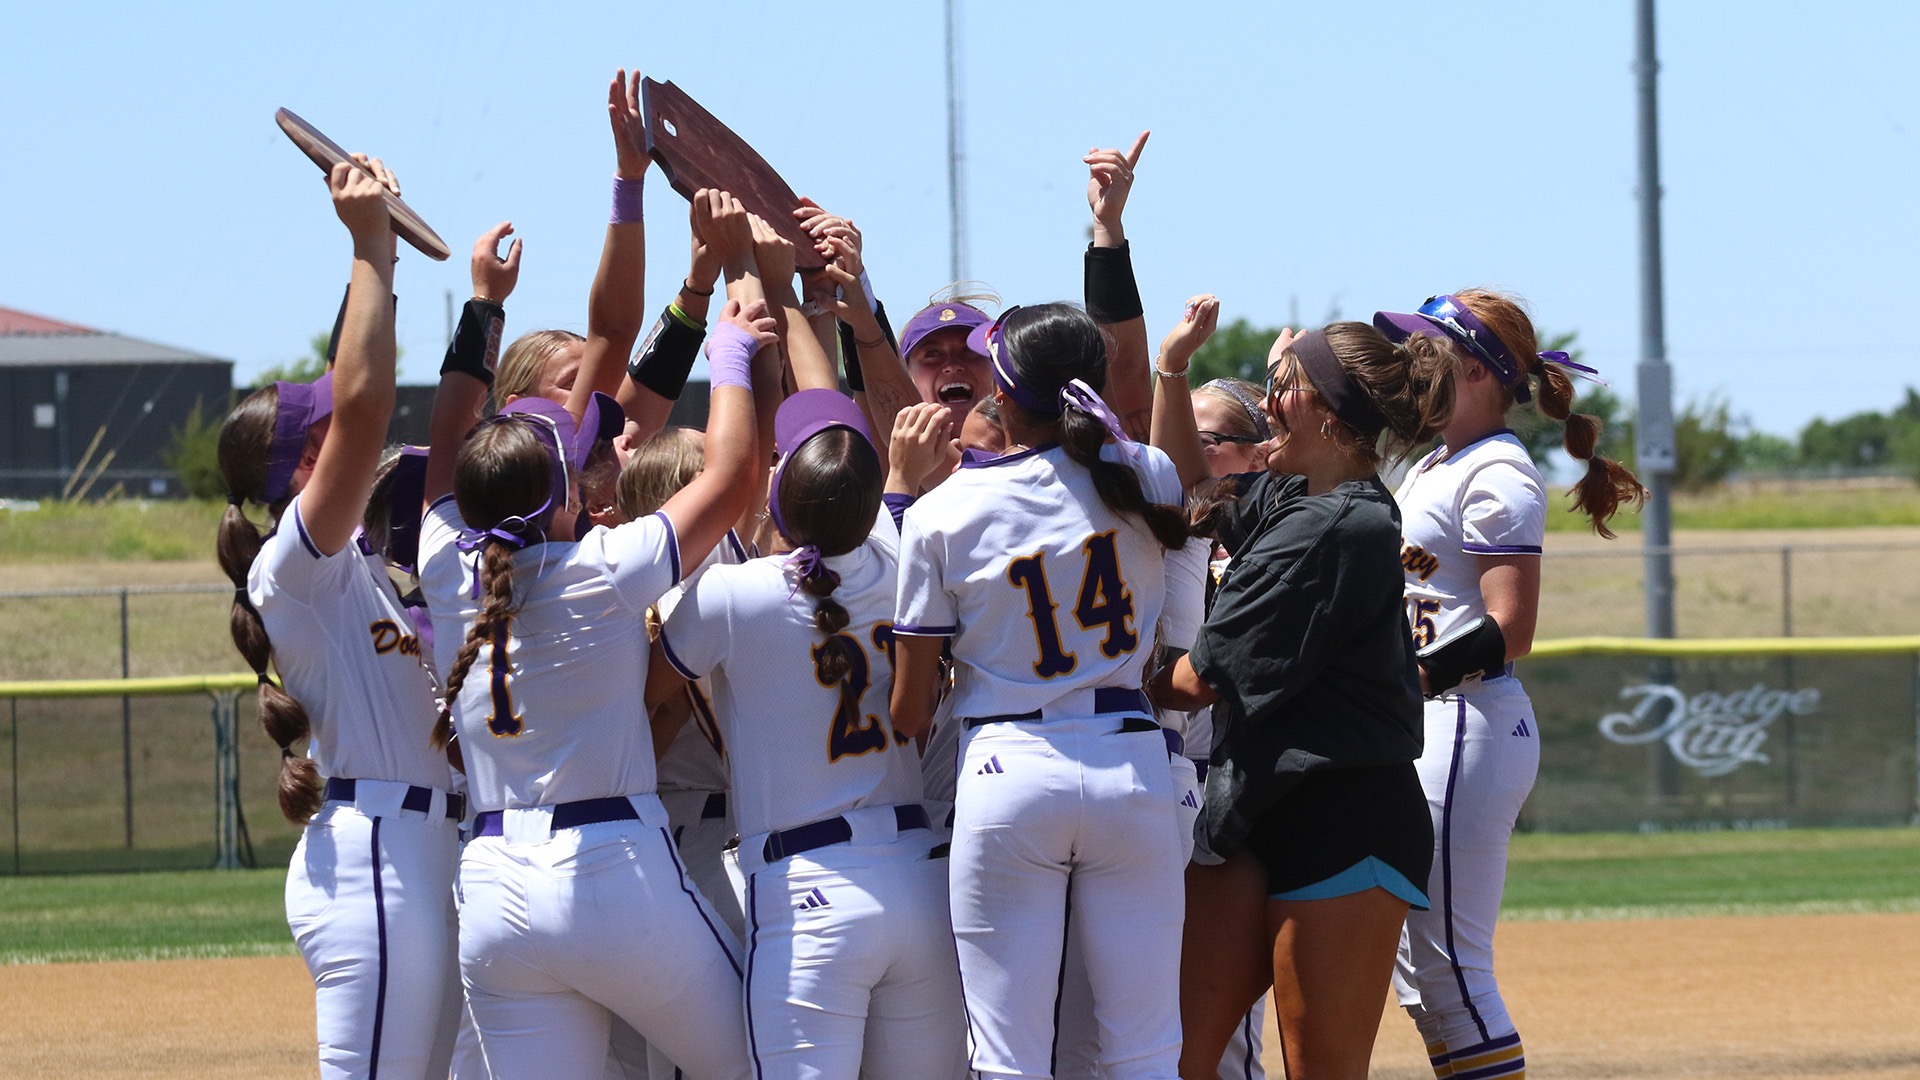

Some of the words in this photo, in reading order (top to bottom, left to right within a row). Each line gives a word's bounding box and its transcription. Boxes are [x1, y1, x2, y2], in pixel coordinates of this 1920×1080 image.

[1401, 538, 1440, 582] ity
[1007, 529, 1138, 680] 14
[476, 610, 525, 738] 1
[1598, 684, 1821, 744] Dodge
[1667, 714, 1770, 777] City
